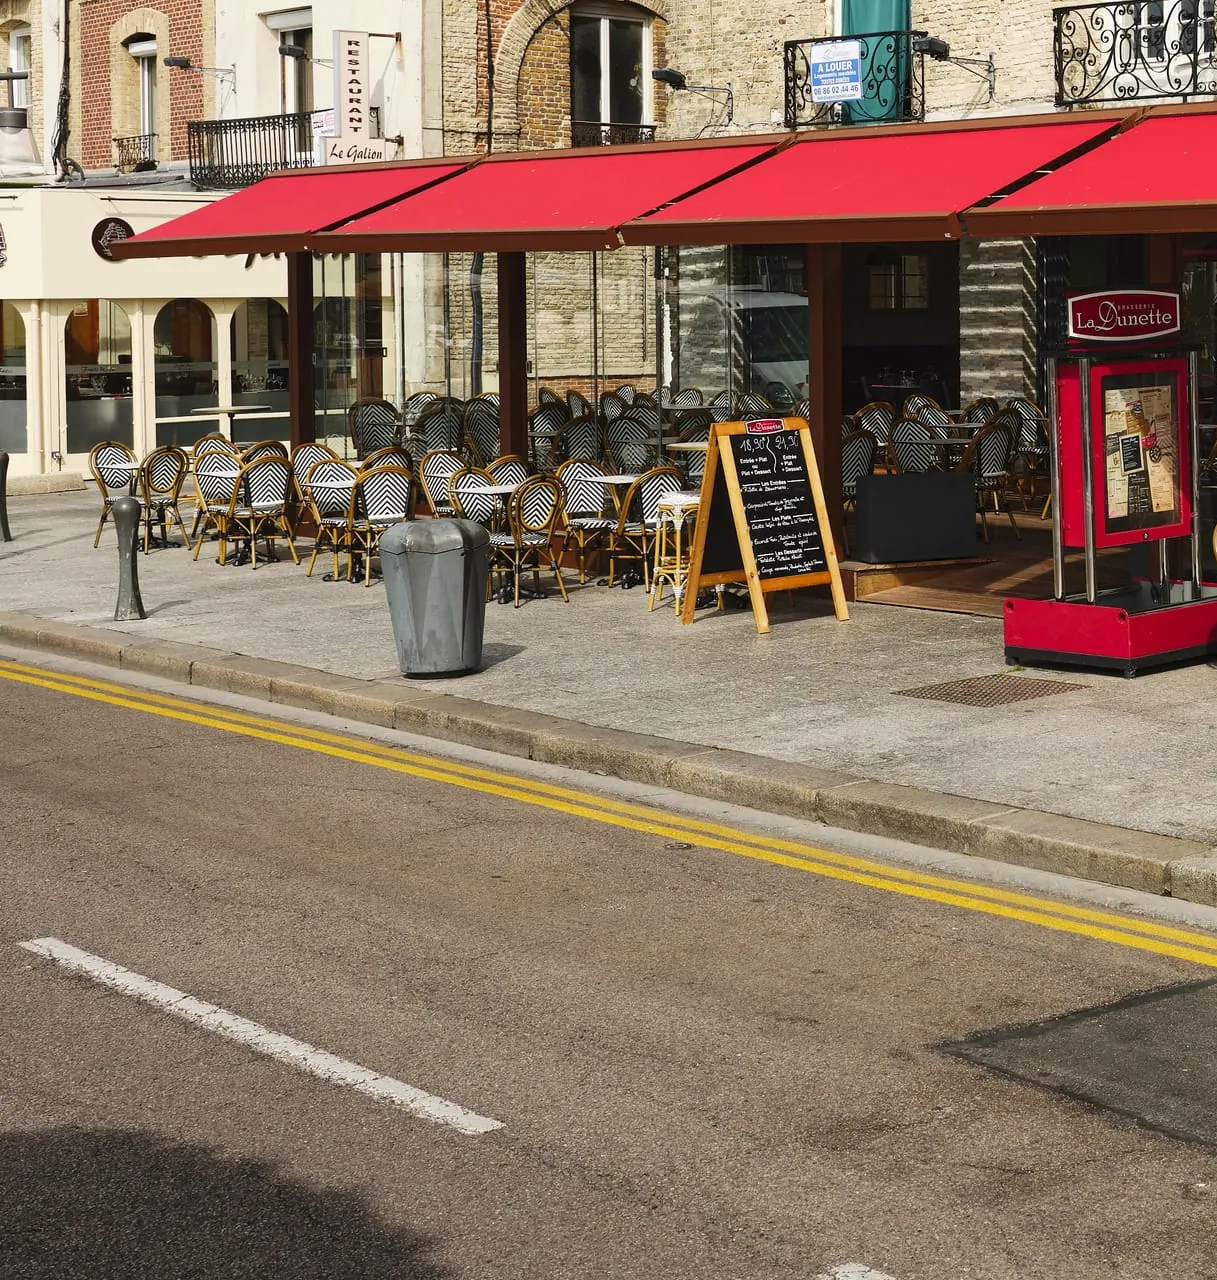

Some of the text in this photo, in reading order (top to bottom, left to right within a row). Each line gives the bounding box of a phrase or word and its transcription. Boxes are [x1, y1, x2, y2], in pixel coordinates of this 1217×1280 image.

[818, 61, 852, 73] A LOUER
[347, 40, 362, 132] RESTAURANT
[813, 87, 822, 96] 06
[822, 86, 831, 95] 86
[831, 85, 840, 94] 02
[850, 84, 859, 92] 46
[330, 143, 382, 162] Le Galion
[1117, 303, 1156, 311] BRASSERIE
[1076, 300, 1172, 331] La Dunette
